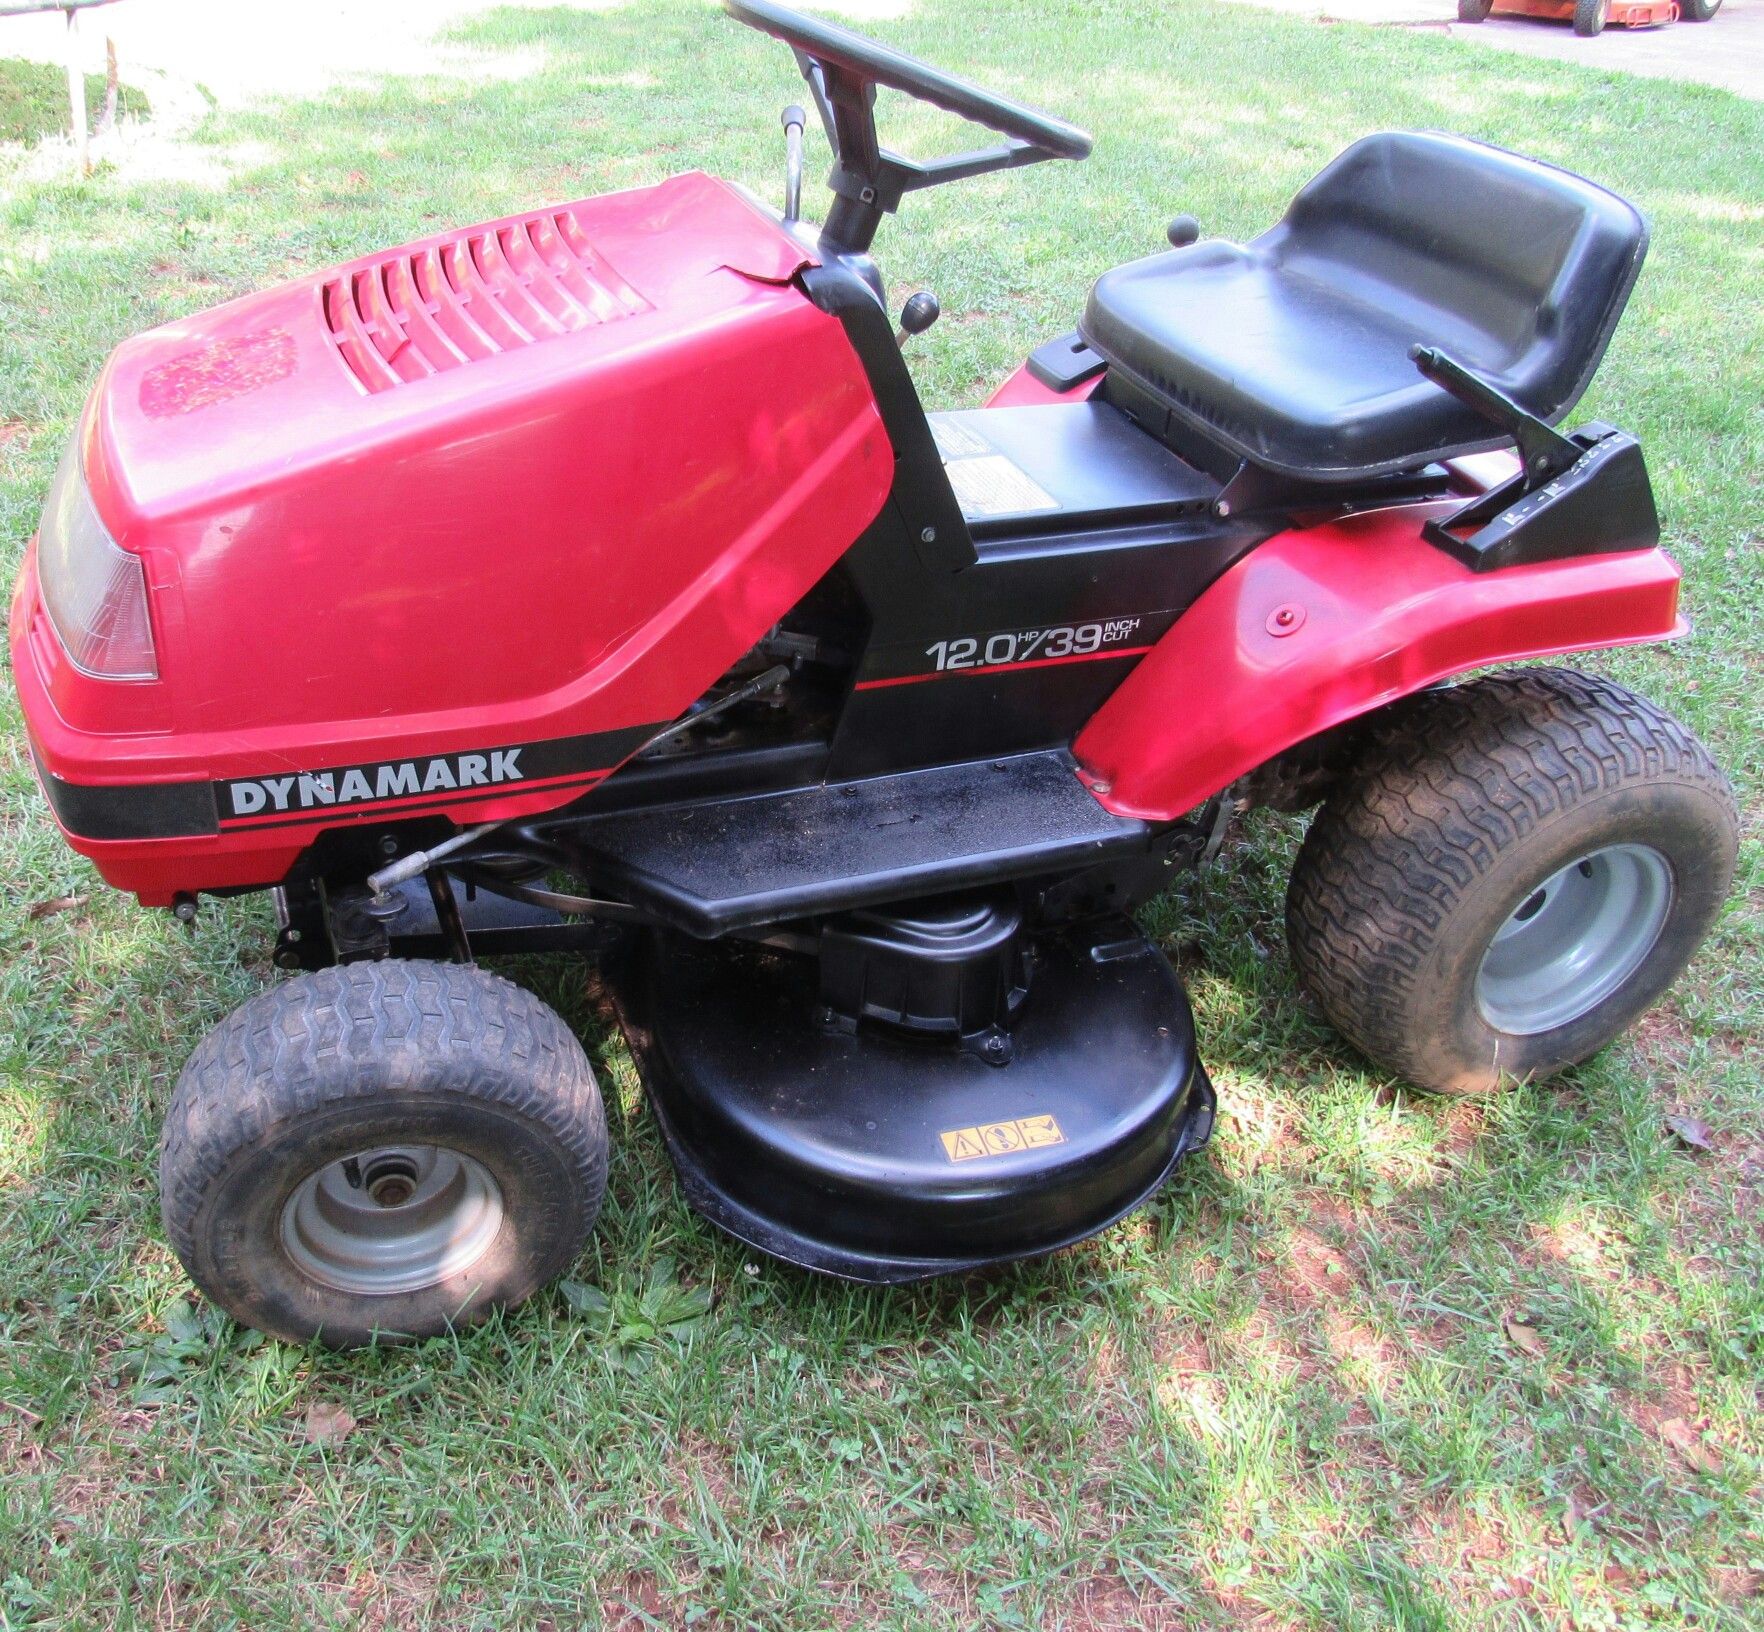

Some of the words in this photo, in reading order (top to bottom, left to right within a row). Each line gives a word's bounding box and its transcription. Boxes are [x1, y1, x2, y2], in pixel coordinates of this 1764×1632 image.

[1104, 618, 1140, 632] INCH
[1102, 629, 1132, 642] CUT
[230, 748, 524, 816] DYNAMARK
